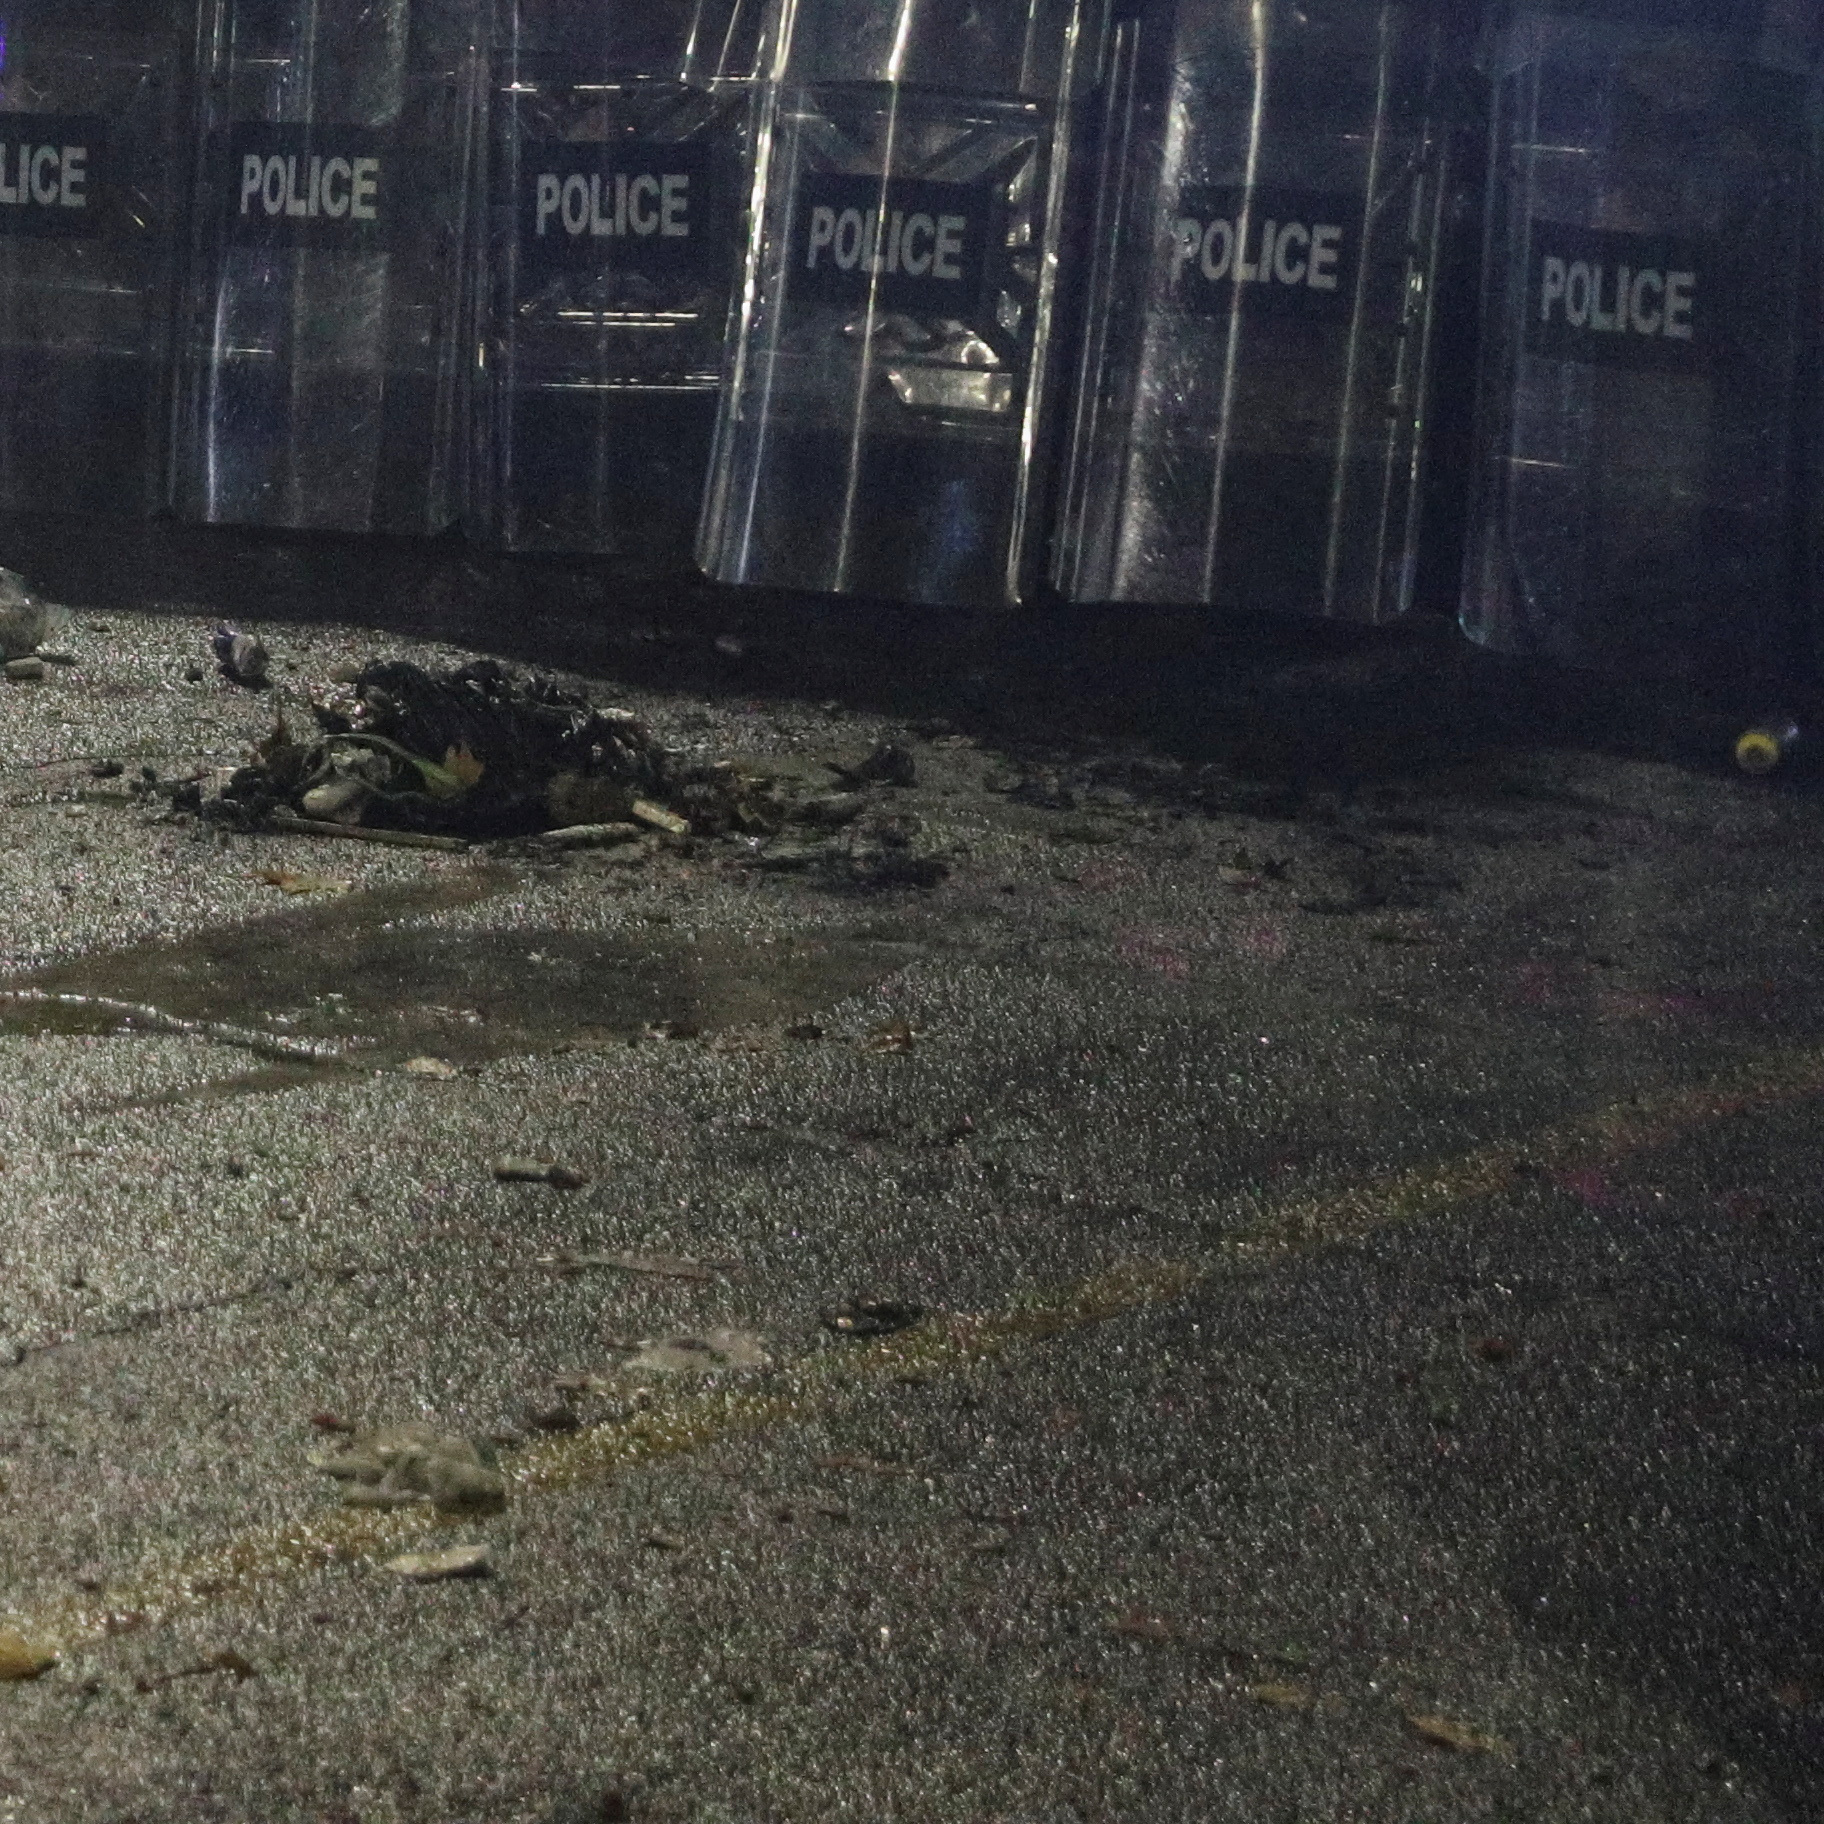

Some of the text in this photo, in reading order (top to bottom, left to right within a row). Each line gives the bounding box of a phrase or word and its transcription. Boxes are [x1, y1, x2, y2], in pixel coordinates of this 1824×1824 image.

[239, 153, 381, 220] POLICE
[535, 172, 690, 238] POLICE
[806, 205, 966, 278] POLICE
[1171, 217, 1342, 291] POLICE
[1540, 255, 1697, 341] POLICE
